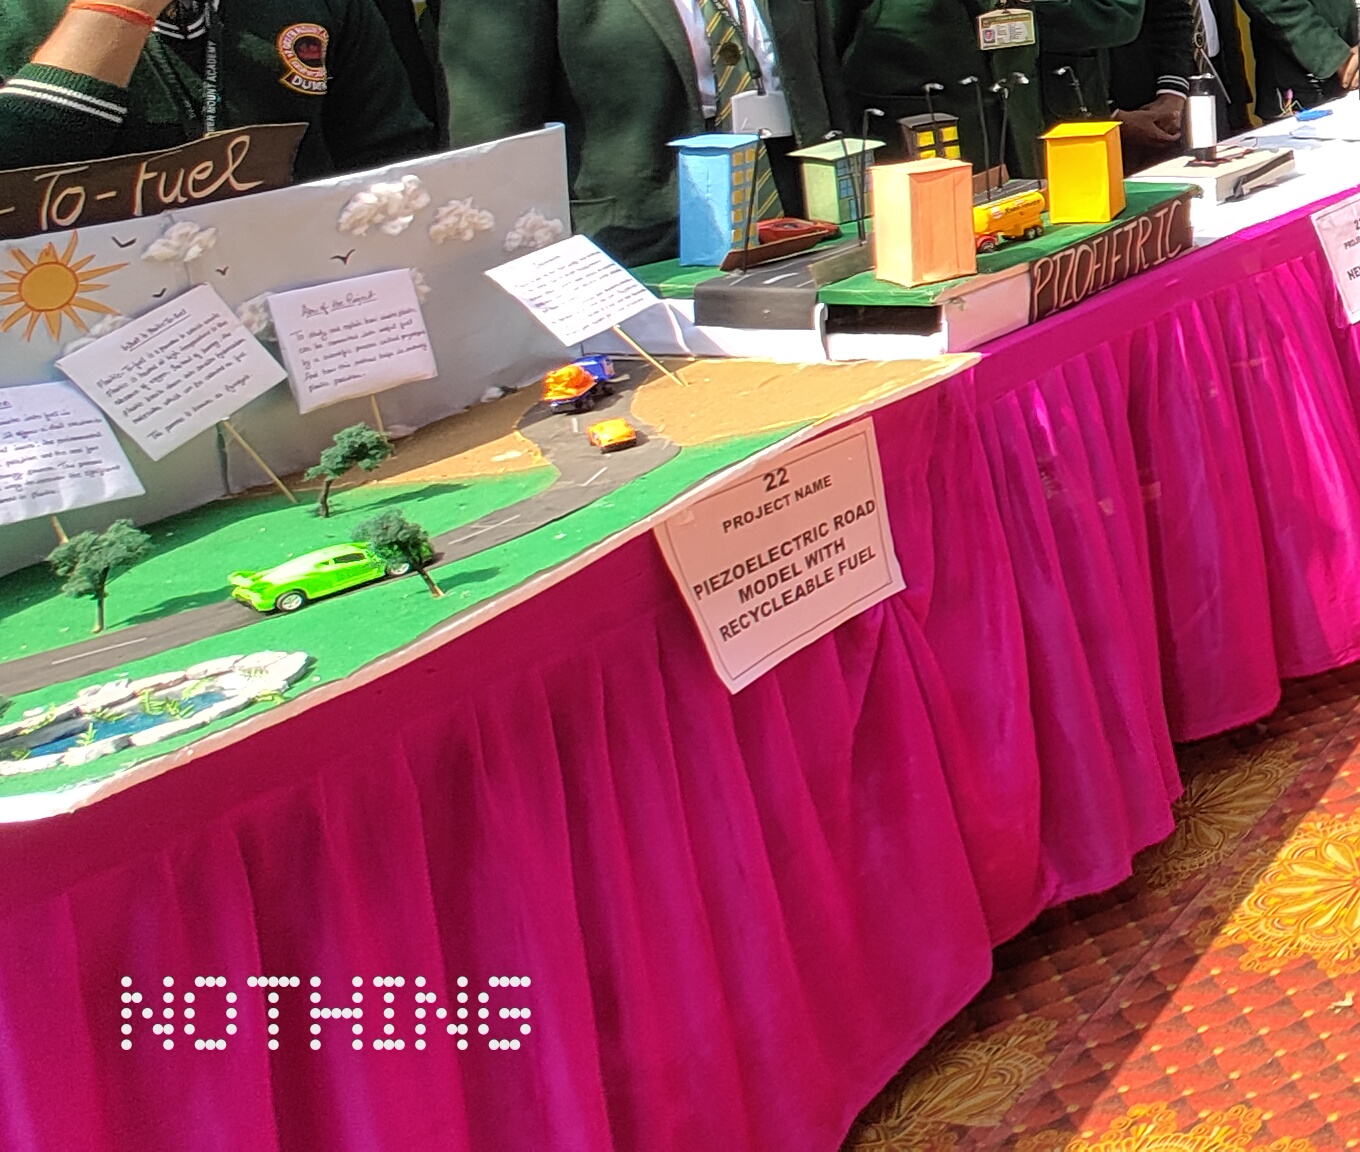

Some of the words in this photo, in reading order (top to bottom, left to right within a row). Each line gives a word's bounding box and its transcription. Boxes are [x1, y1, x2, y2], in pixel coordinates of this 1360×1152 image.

[722, 496, 791, 534] PROJECT
[795, 474, 833, 502] NAME
[762, 467, 790, 493] 22
[692, 521, 830, 601] PIEZOELECTRIC
[832, 499, 876, 531] ROAD
[737, 562, 803, 604] MODEL
[805, 537, 847, 569] WITH
[718, 567, 836, 642] RECYCLEABLE
[838, 545, 877, 576] FUEL
